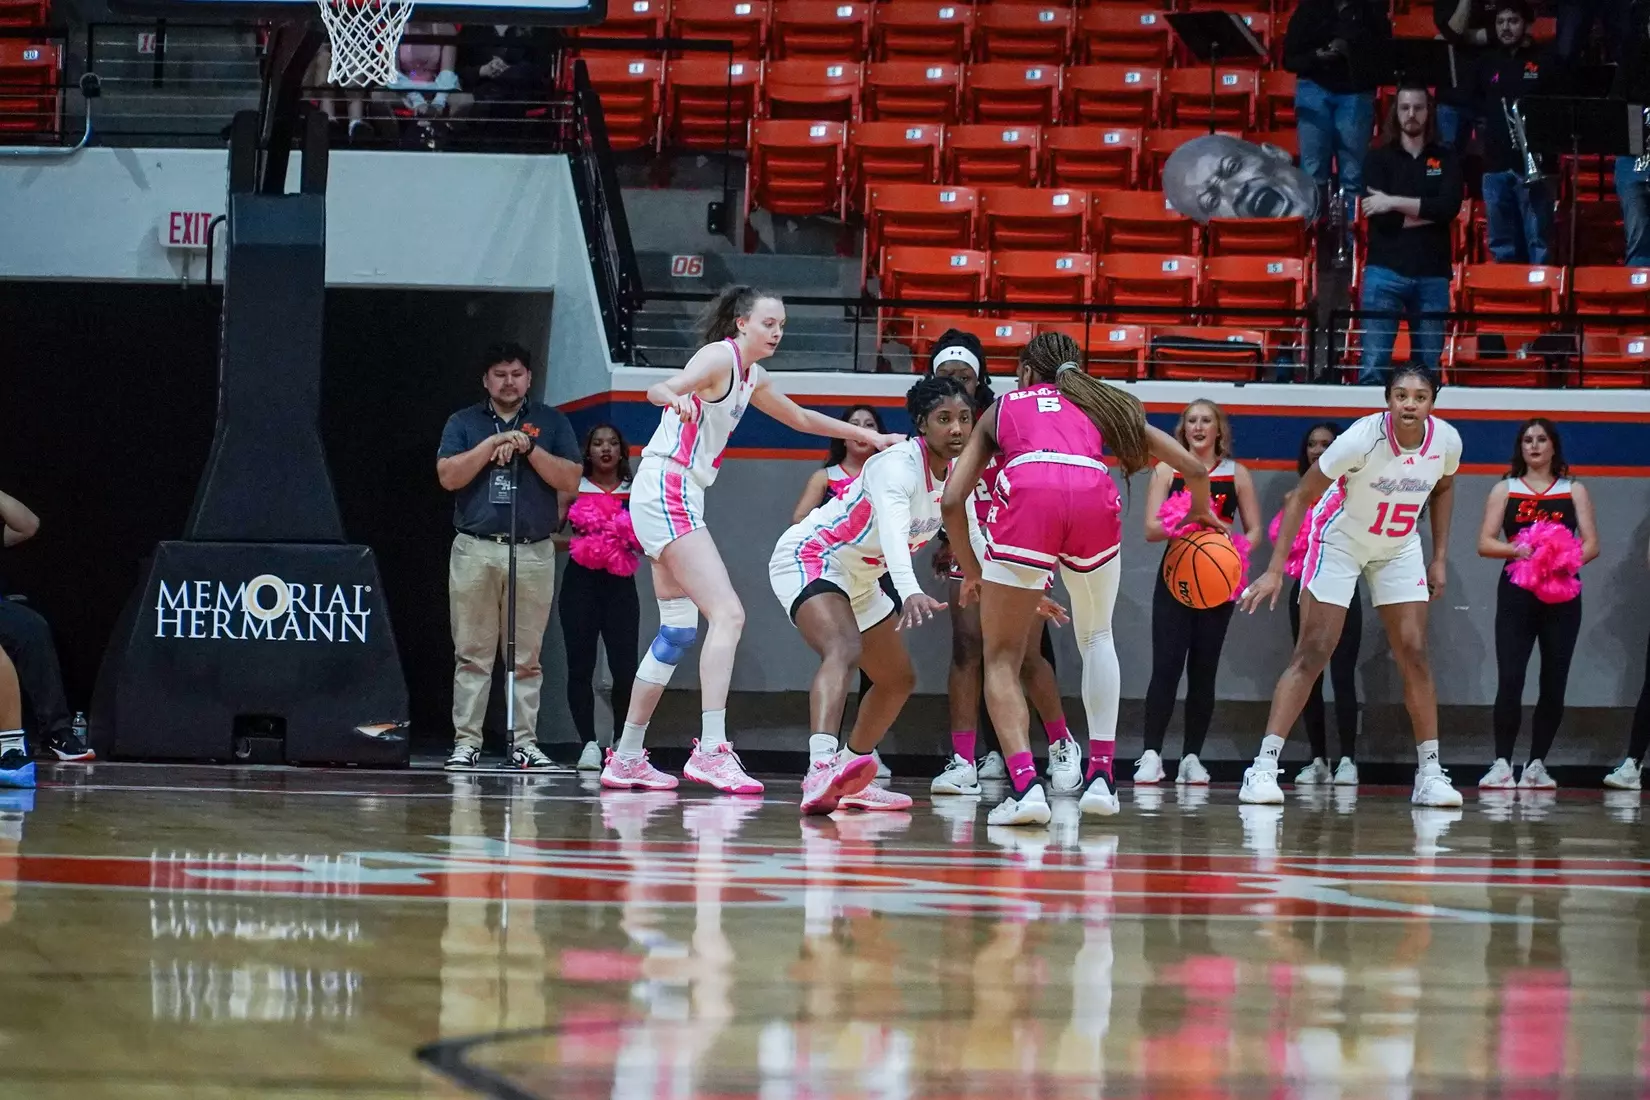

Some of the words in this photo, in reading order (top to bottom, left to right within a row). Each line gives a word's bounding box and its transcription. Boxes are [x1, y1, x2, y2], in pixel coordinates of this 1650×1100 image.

[169, 212, 212, 244] EXIT
[673, 256, 702, 276] 06
[1037, 397, 1061, 413] 5
[1368, 502, 1419, 537] 15
[155, 574, 371, 619] MEMORIAL
[155, 607, 368, 643] HERMANN
